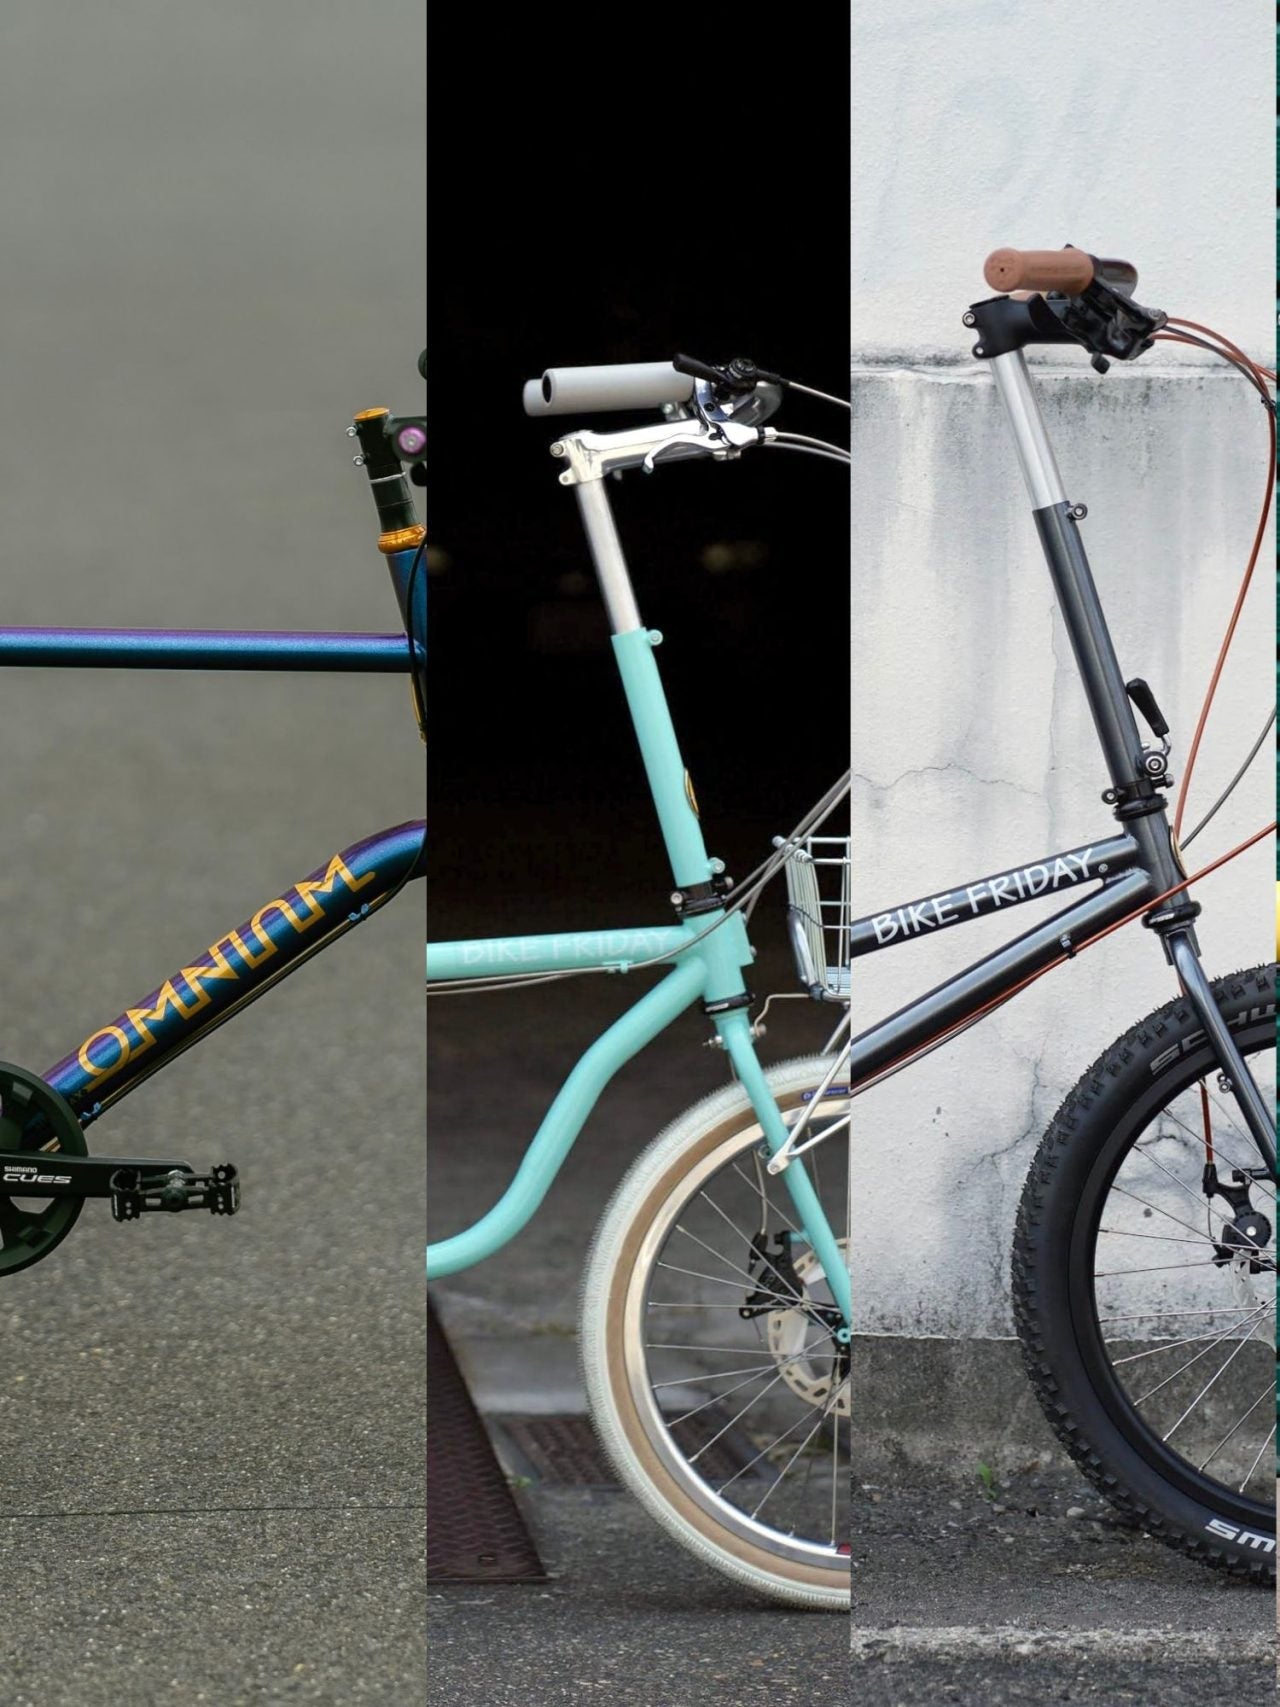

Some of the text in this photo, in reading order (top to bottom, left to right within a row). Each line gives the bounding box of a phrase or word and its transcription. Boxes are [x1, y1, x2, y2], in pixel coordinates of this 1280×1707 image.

[871, 848, 1094, 945] BIKE FRIDAY
[462, 930, 670, 965] BIKE FRIDAY
[78, 854, 376, 1092] OMNIUM
[3, 1173, 72, 1184] CUES
[4, 1165, 38, 1173] SHIMANO
